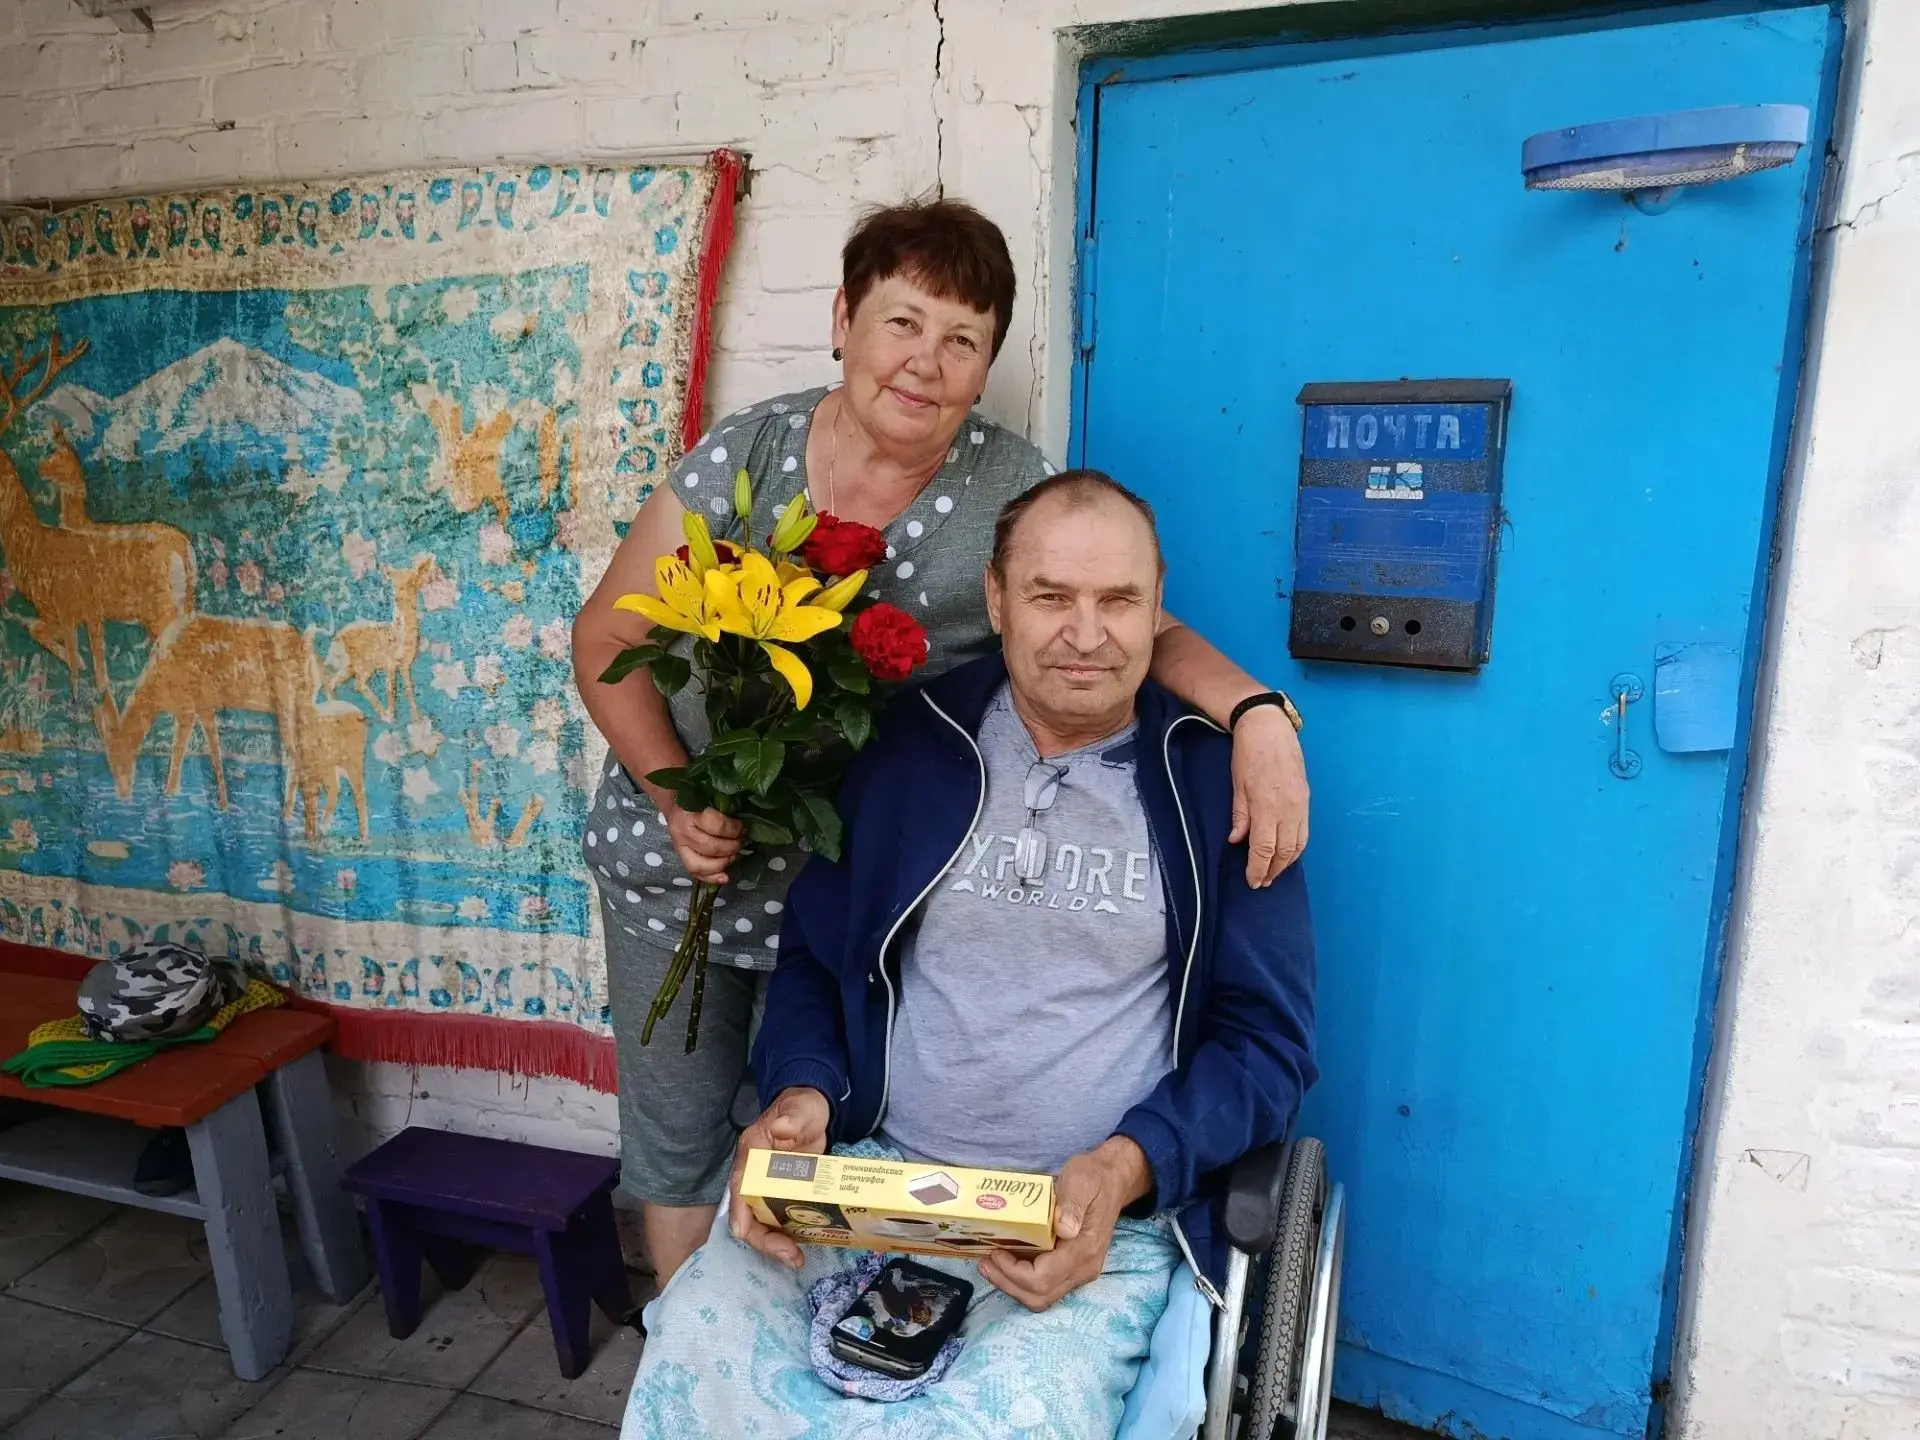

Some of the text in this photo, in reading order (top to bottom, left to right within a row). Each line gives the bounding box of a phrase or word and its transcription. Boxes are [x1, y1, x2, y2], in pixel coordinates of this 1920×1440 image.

[1326, 414, 1460, 449] ПОЧТА
[950, 833, 1149, 901] XPLORE
[982, 883, 1088, 912] WORLD
[841, 1174, 885, 1185] вафельный
[843, 1163, 903, 1176] глазированный
[839, 1183, 860, 1194] Торт
[979, 1176, 1043, 1207] Алёнка
